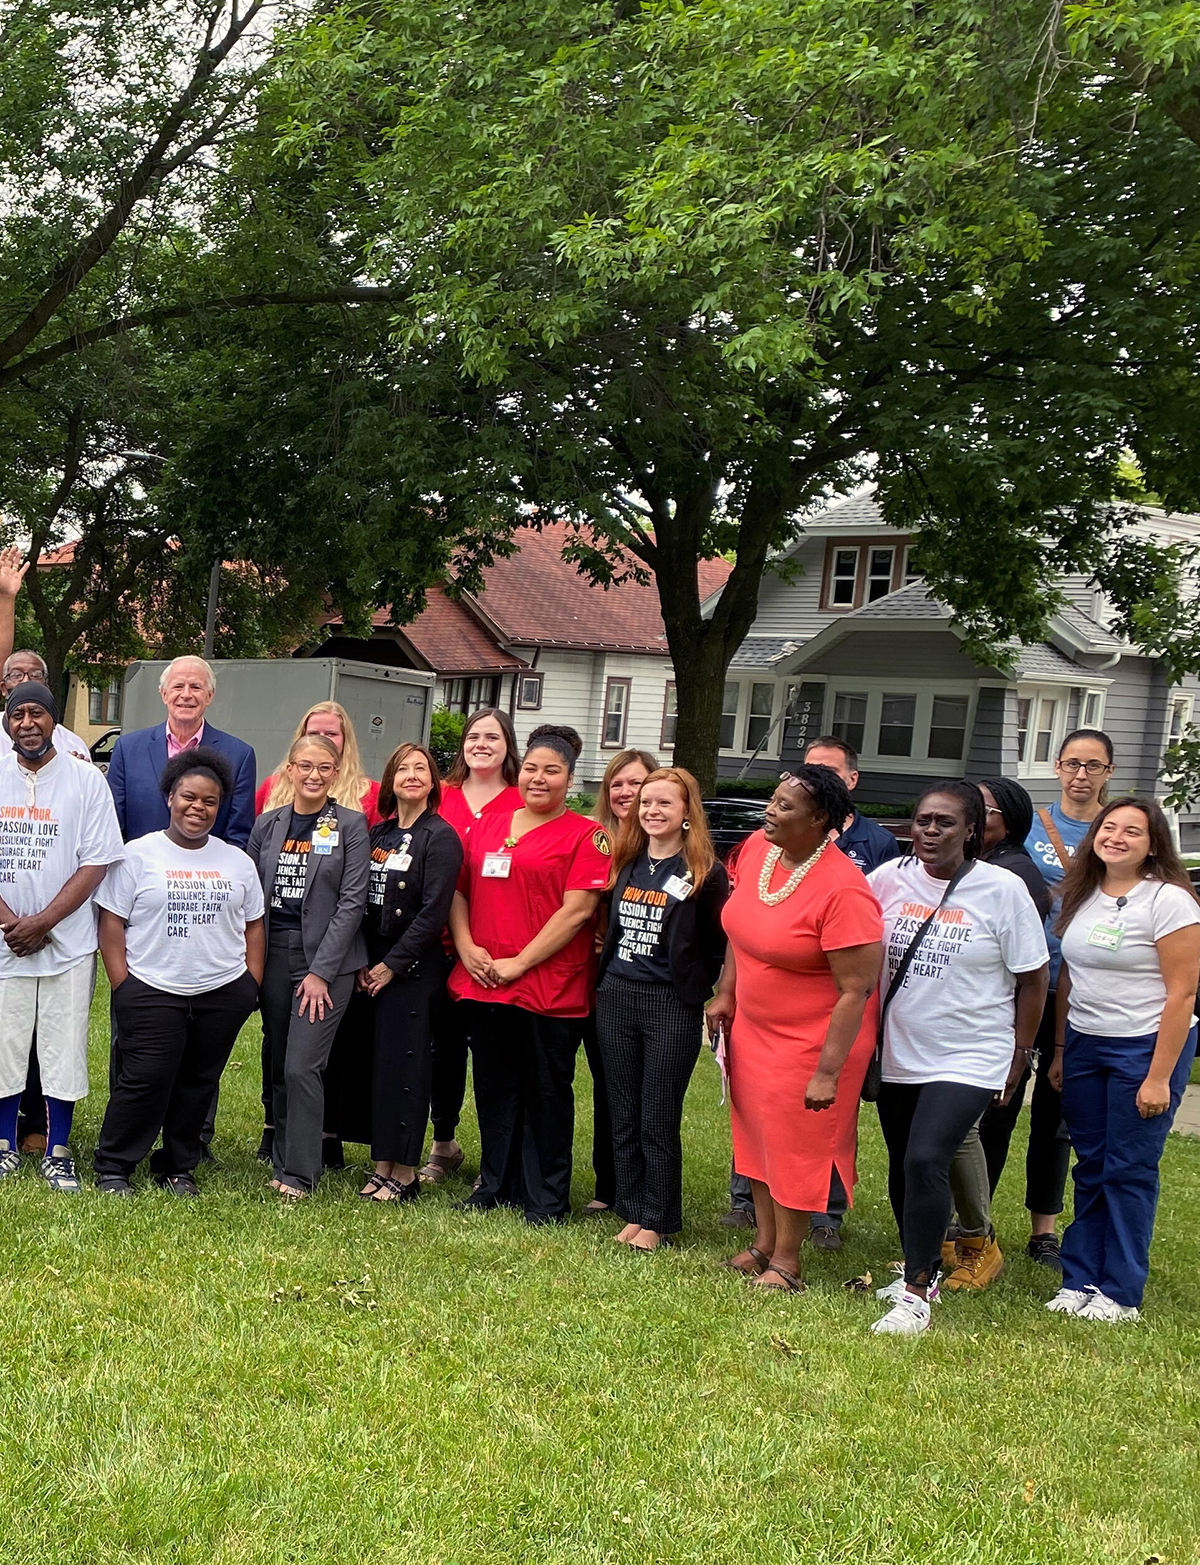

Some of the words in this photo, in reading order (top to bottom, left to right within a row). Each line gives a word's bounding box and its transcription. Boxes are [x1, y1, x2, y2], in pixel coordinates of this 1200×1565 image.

[797, 702, 811, 748] 3829
[0, 806, 25, 819] SHOW
[0, 821, 35, 835] PASSION.
[39, 823, 60, 836] LOVE.
[0, 835, 33, 846] RESILIENCE.
[35, 838, 55, 848] FIGHT.
[295, 841, 311, 853] YOU
[0, 847, 26, 857] COURAGE.
[28, 849, 48, 859] FAITH.
[279, 853, 300, 865] SION.
[0, 859, 16, 869] HOPE.
[18, 860, 43, 871] HEART.
[0, 872, 17, 883] CARE.
[165, 870, 192, 879] SHOW
[167, 880, 209, 890] PASSION.
[212, 880, 235, 892] LOVE.
[292, 877, 306, 886] FAIT
[168, 891, 207, 901] RESILIENCE.
[210, 892, 231, 902] FIGHT.
[623, 886, 644, 902] HOW
[168, 902, 200, 911] COURAGE.
[202, 903, 222, 912] FAITH.
[900, 902, 935, 920] SHOW
[168, 913, 189, 924] HOPE.
[193, 914, 217, 924] HEART.
[167, 926, 190, 938] CARE.
[647, 921, 663, 933] FIGH
[637, 931, 659, 944] FAITH.
[944, 927, 973, 943] LOVE.
[632, 942, 653, 957] EART.
[937, 941, 964, 955] FIGHT.
[927, 952, 951, 966] FAITH.
[913, 963, 943, 980] HEART.
